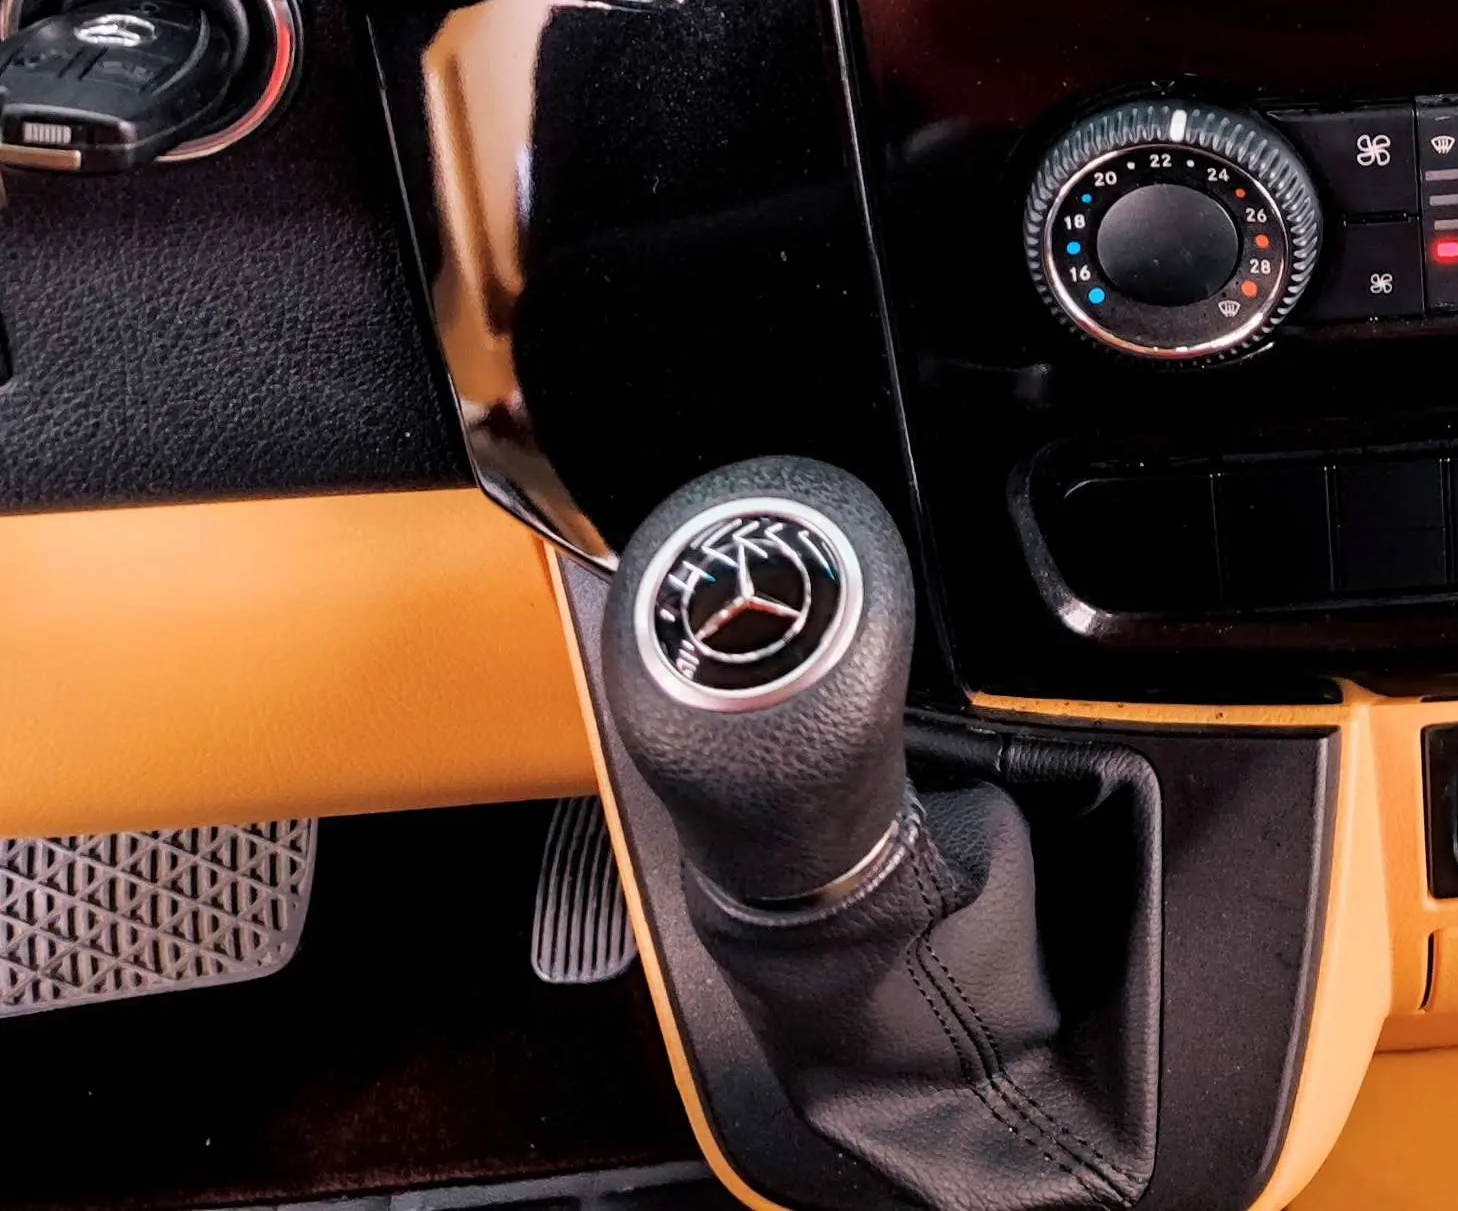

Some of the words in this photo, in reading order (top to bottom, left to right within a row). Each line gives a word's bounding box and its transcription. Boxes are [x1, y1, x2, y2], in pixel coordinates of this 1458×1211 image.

[1150, 153, 1172, 168] 22
[1095, 170, 1116, 186] 20
[1207, 167, 1229, 183] 24
[1063, 214, 1085, 230] 18
[1245, 208, 1267, 223] 26
[1069, 265, 1091, 281] 16
[1250, 259, 1271, 275] 28
